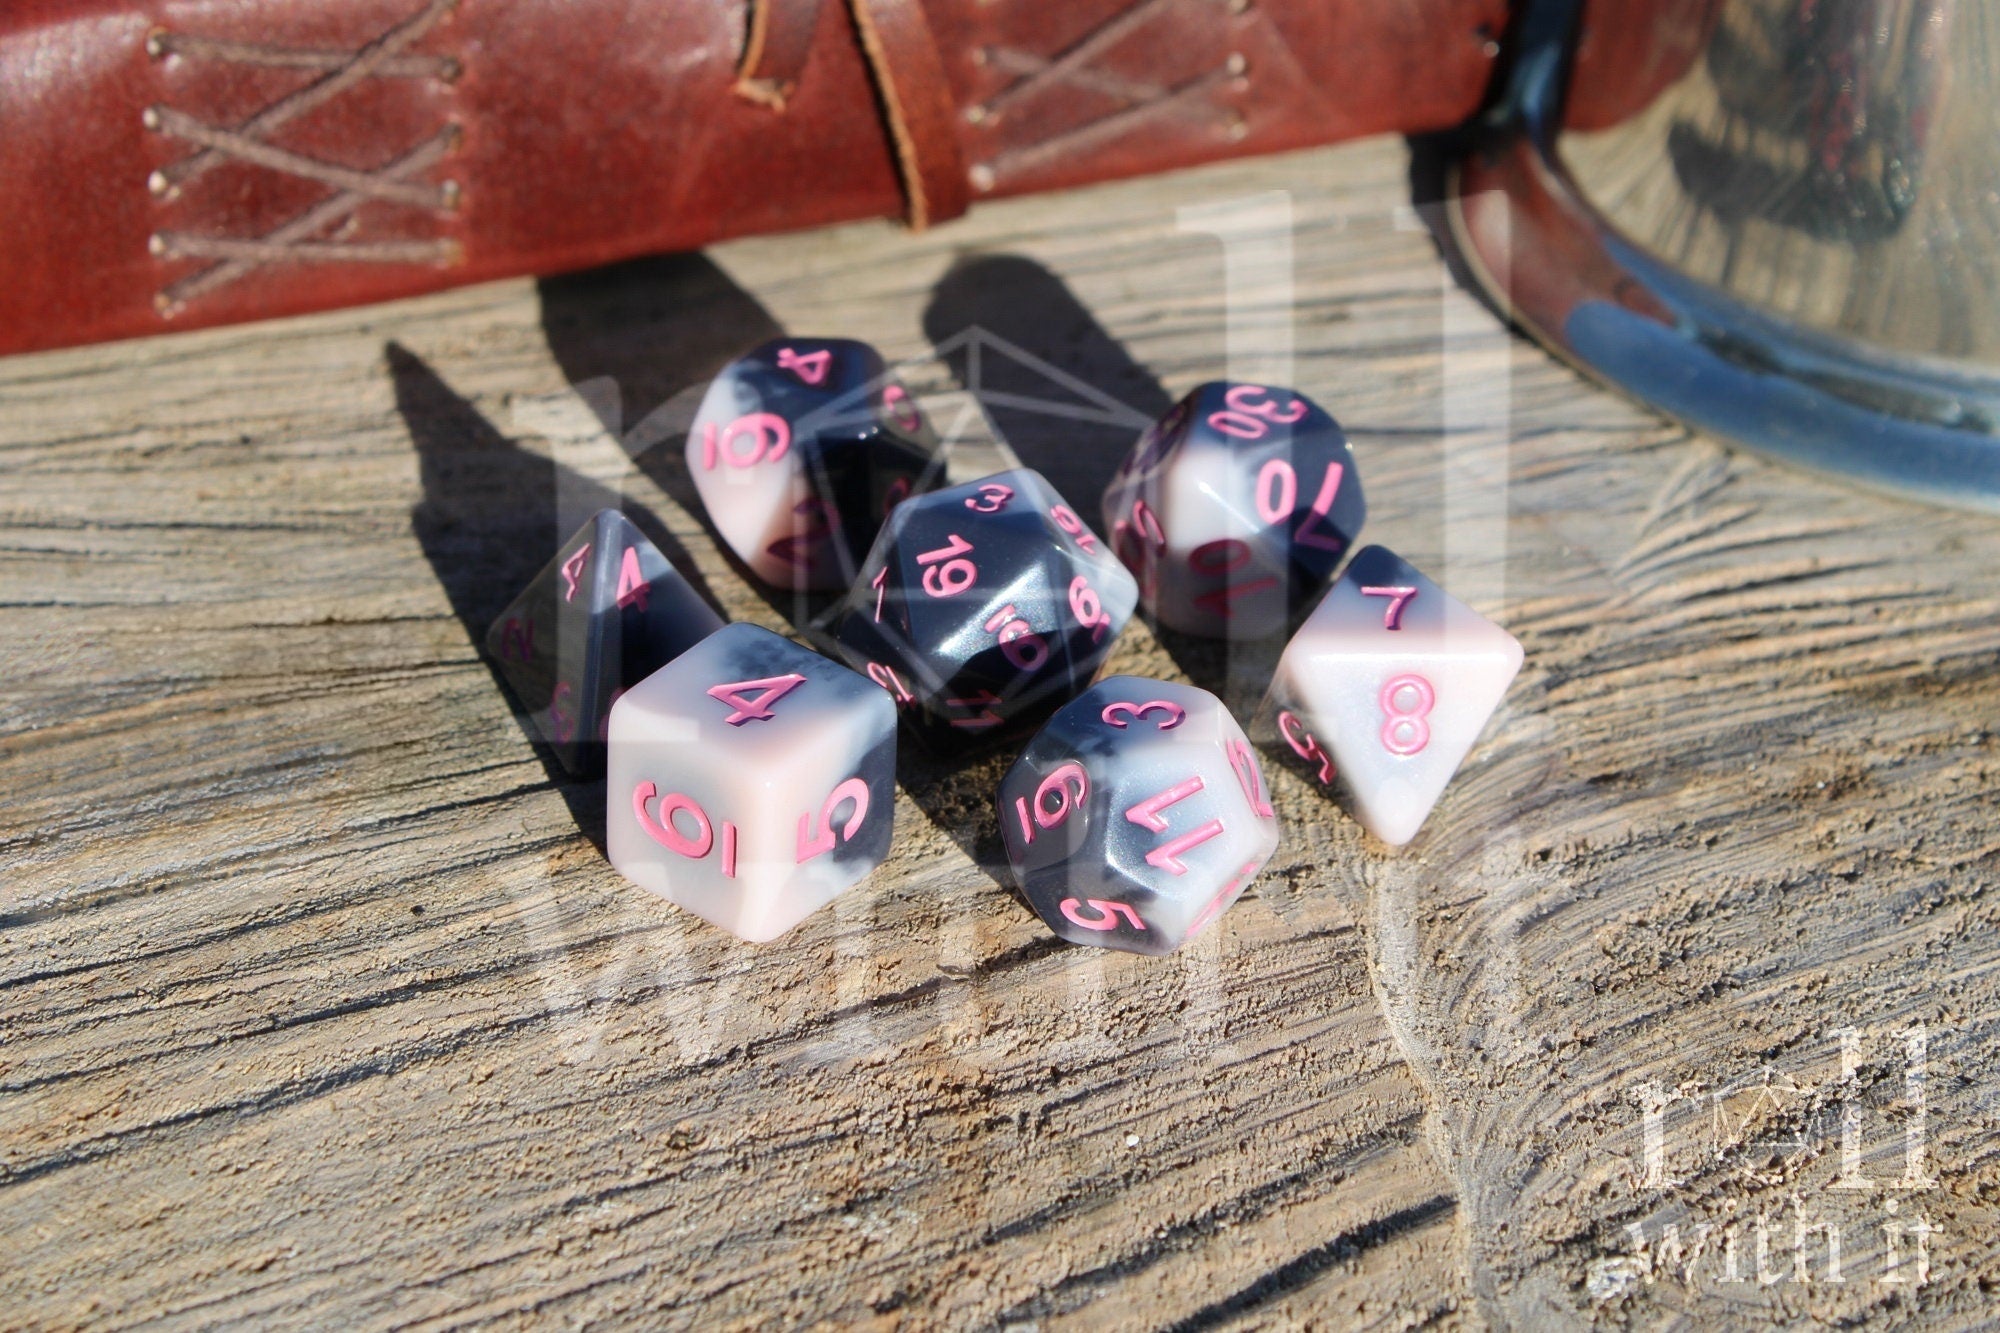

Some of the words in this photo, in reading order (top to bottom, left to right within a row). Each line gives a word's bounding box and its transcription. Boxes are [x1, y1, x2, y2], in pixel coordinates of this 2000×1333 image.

[776, 346, 833, 386] 4
[1206, 384, 1308, 440] 30
[964, 483, 1014, 513] 3
[1255, 458, 1345, 551] 70
[1050, 504, 1096, 556] 16
[560, 542, 593, 604] 4
[615, 546, 650, 613] 4
[872, 566, 888, 624] 1
[916, 534, 976, 599] 19
[1360, 586, 1418, 631] 7
[706, 673, 808, 728] 4
[946, 688, 1006, 728] 11
[1101, 700, 1187, 731] 3
[1378, 673, 1436, 757] 8
[1278, 711, 1337, 785] 5
[632, 780, 738, 879] 6
[796, 776, 871, 865] 5
[1124, 775, 1225, 877] 11
[1059, 897, 1147, 931] 5
